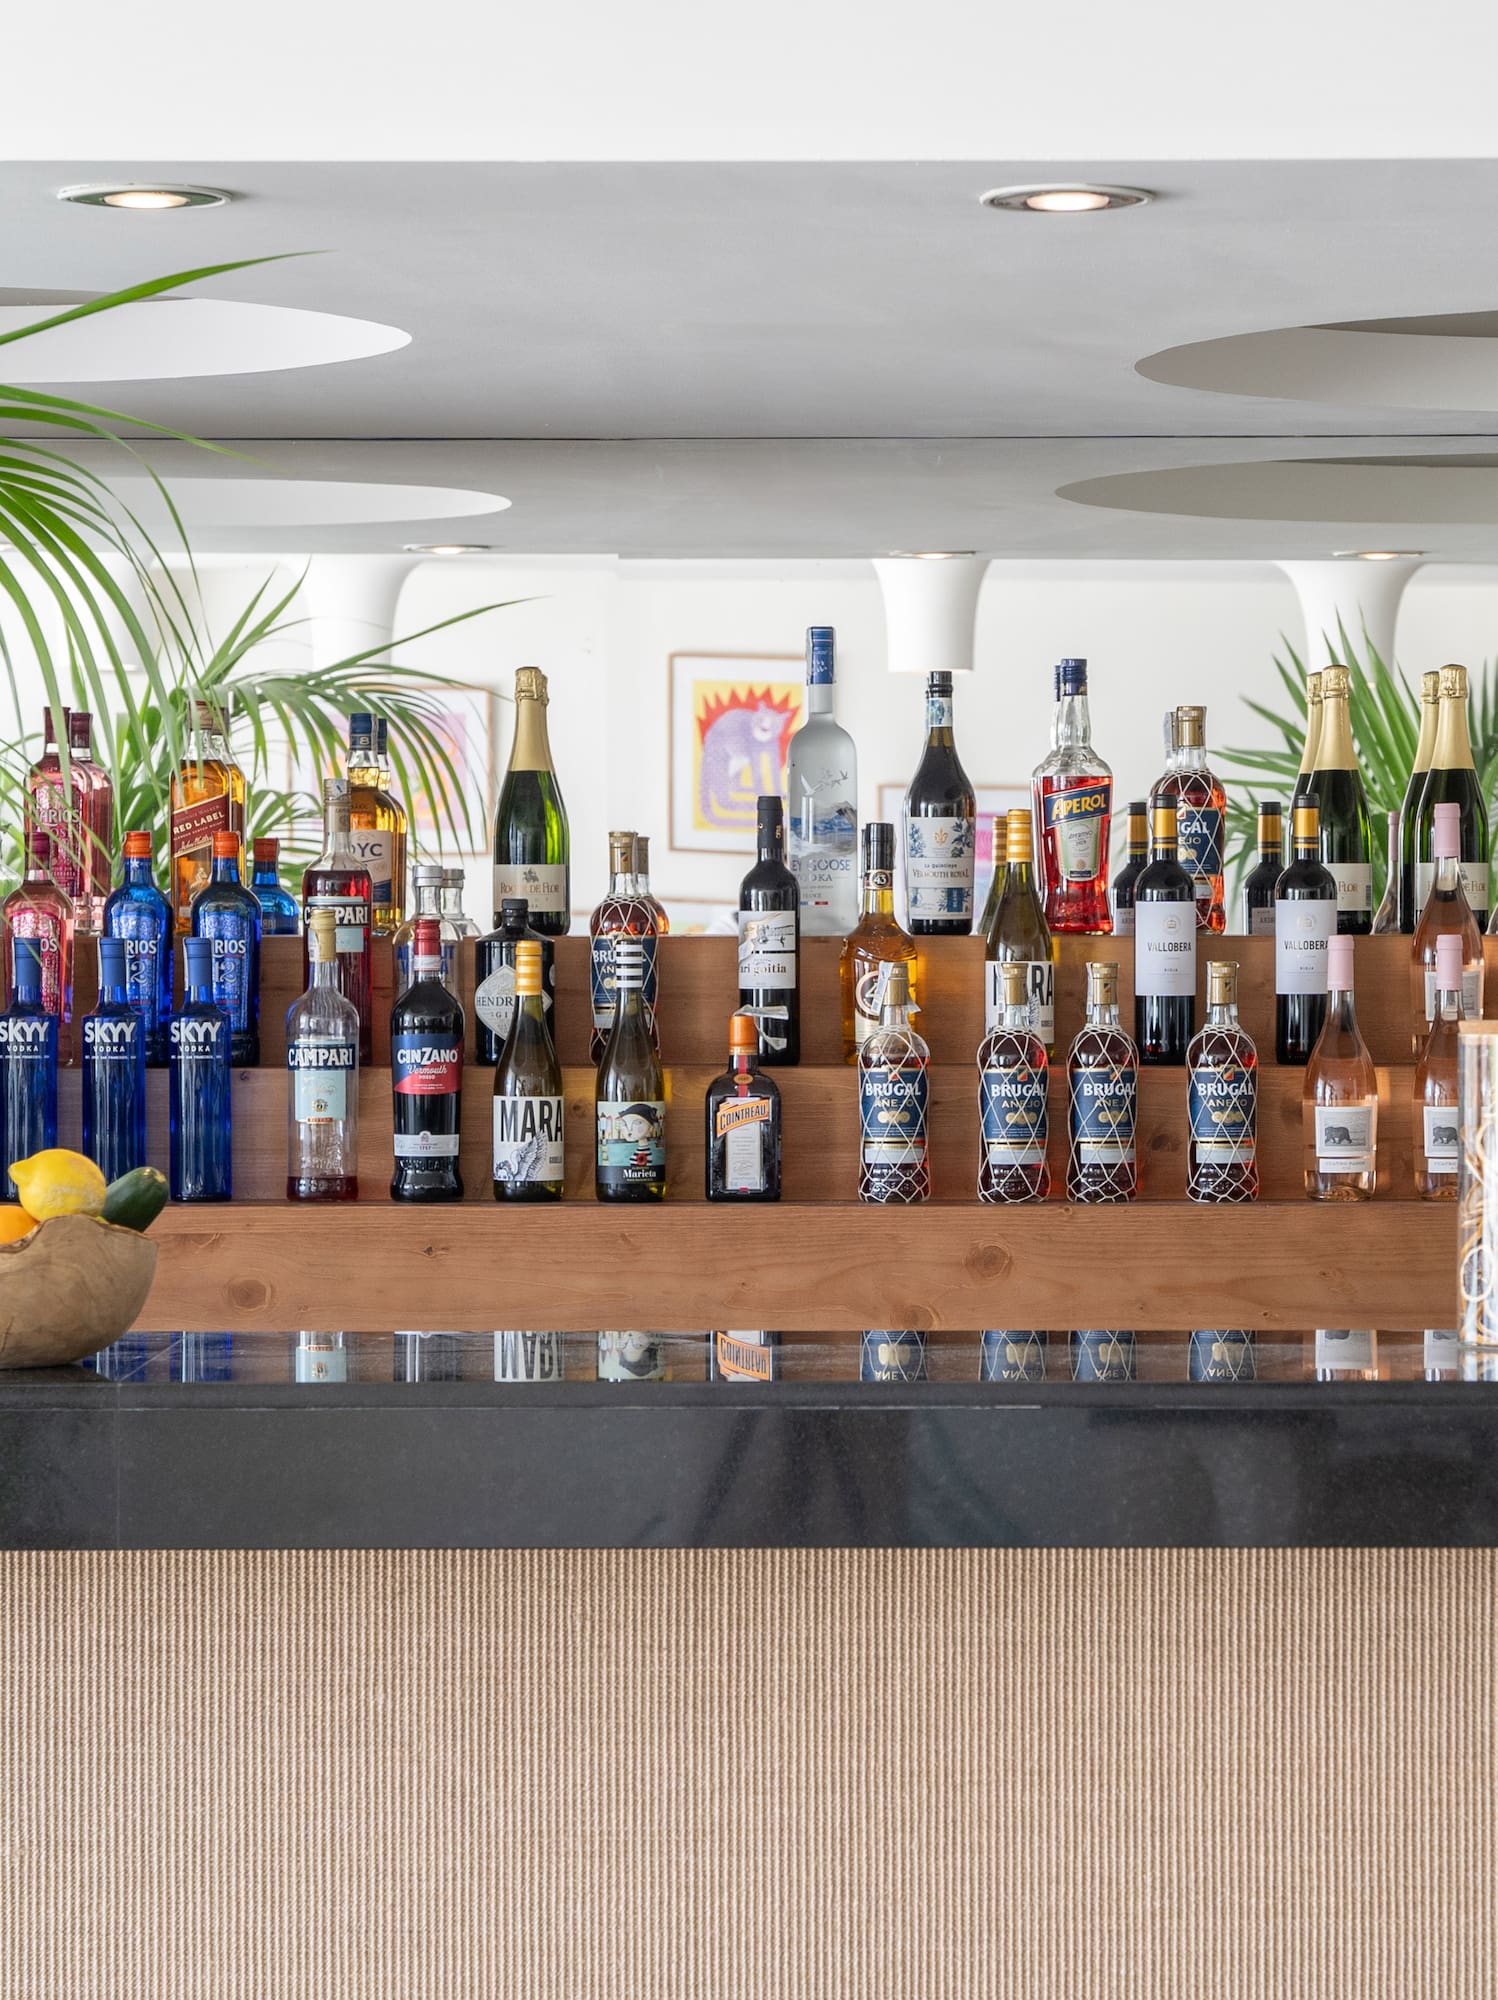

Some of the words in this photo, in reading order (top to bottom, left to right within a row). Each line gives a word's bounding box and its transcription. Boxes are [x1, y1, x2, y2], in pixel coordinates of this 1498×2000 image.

[359, 736, 369, 745] 8
[1051, 793, 1106, 820] APEROL
[173, 822, 192, 835] RED
[194, 811, 225, 828] LABEL
[808, 858, 850, 871] GOOSE
[542, 881, 560, 894] FLOR
[873, 875, 887, 885] 43
[1338, 880, 1358, 893] FLOR
[1147, 942, 1192, 952] VALLOBERA
[0, 1021, 49, 1042] SKYY
[84, 1021, 134, 1043] SKYY
[170, 1021, 221, 1043] SKYY
[93, 1045, 126, 1053] VODKA
[179, 1045, 211, 1053] VODKA
[397, 1047, 458, 1065] CINZANO
[288, 1048, 353, 1067] CAMPARI
[407, 1064, 448, 1075] Vermouth
[865, 1082, 922, 1097] BRUGAL
[991, 1083, 1046, 1098] BRUGAL
[1083, 1082, 1136, 1097] BRUGAL
[1198, 1082, 1254, 1097] BRUGAL
[501, 1100, 563, 1143] MARA
[720, 1103, 767, 1131] COINTREAU
[622, 1168, 657, 1179] Marieta
